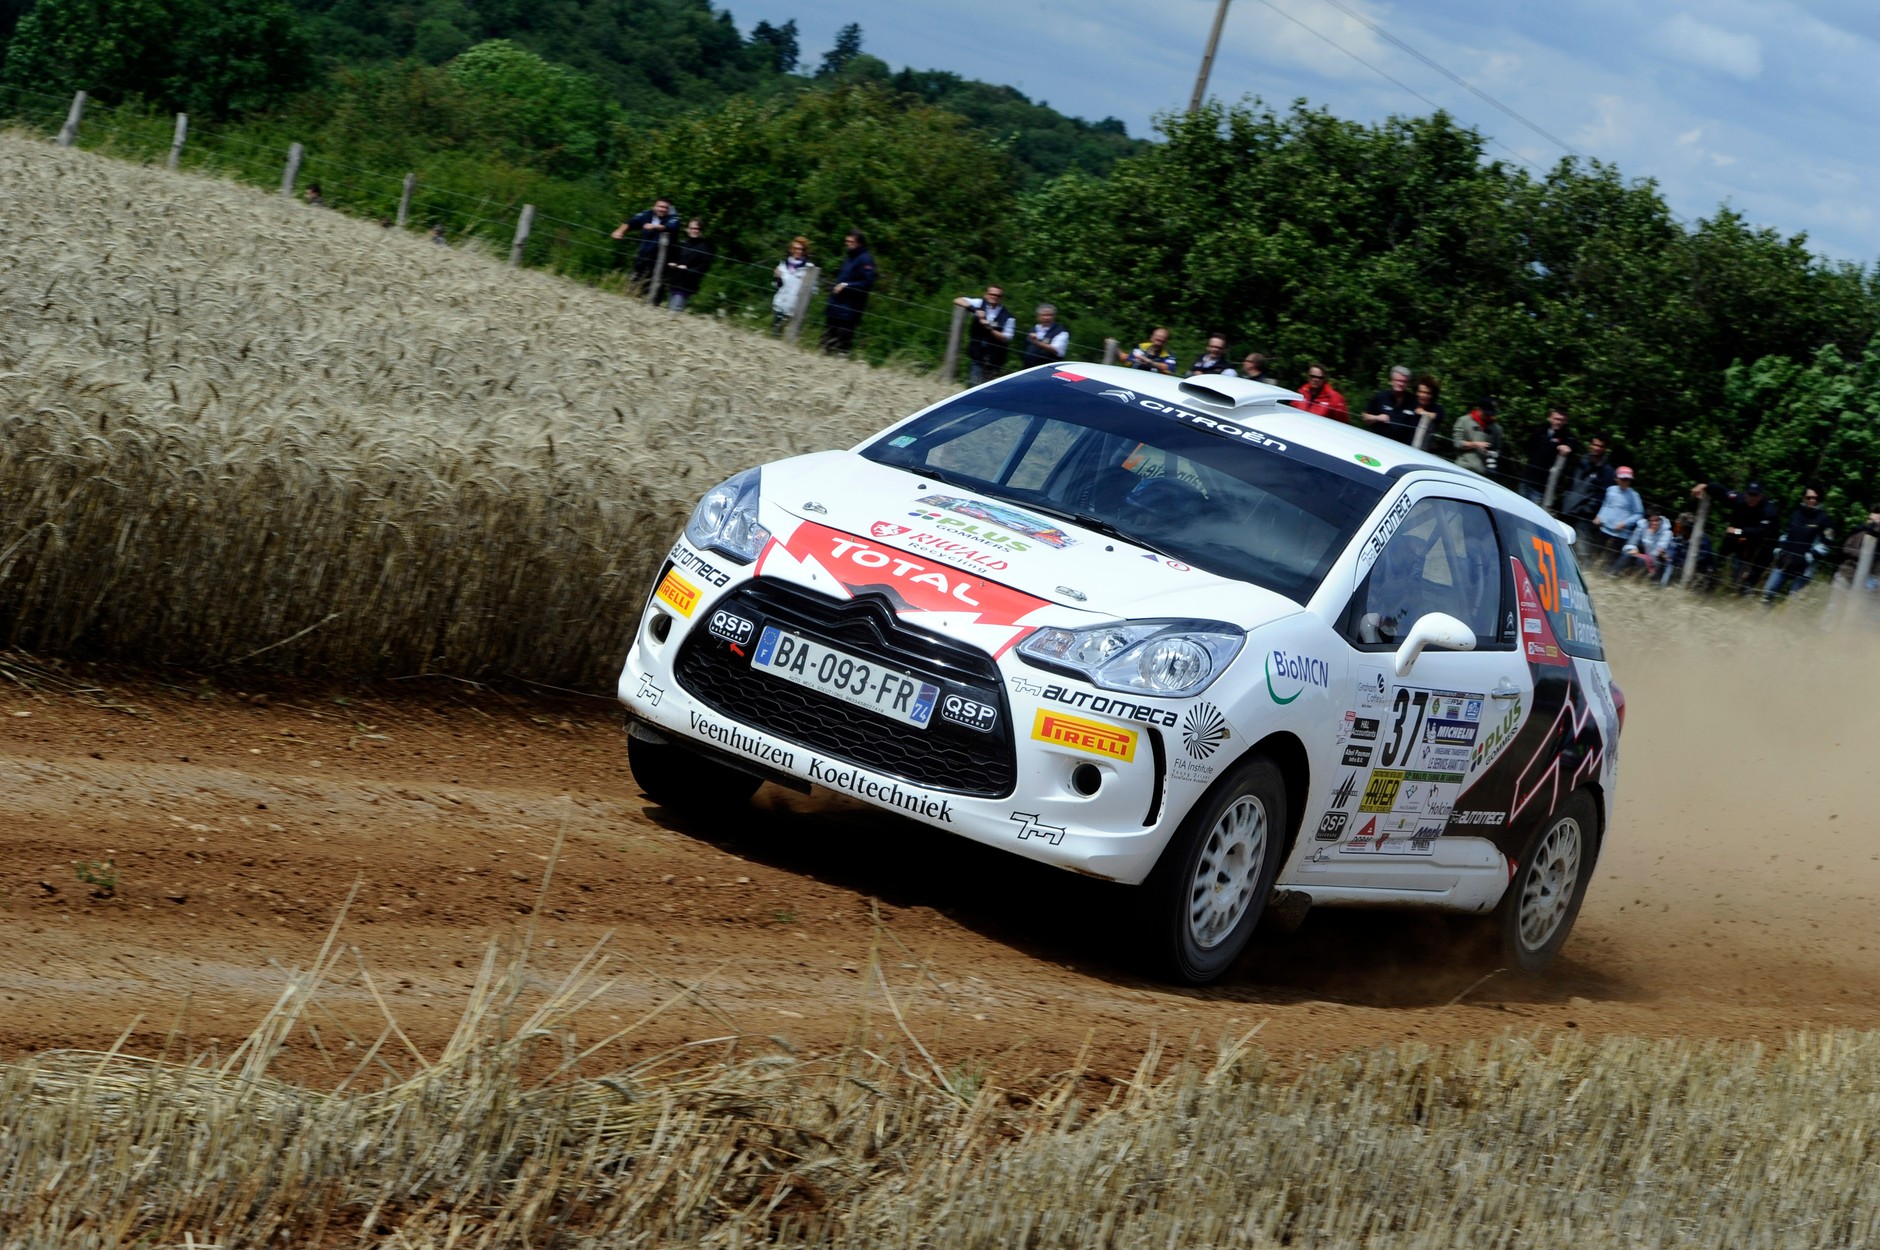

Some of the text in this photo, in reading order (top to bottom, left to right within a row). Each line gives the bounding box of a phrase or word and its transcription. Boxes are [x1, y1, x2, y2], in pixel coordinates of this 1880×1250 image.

[1139, 399, 1288, 452] CITROËN
[909, 533, 1009, 571] RIWALD
[935, 524, 1011, 553] GOMMERS
[937, 517, 1032, 552] PLUS
[829, 536, 980, 607] TOTAL
[908, 542, 987, 574] Recycling
[1531, 536, 1559, 614] 37
[713, 613, 752, 635] QSP
[760, 649, 768, 658] F
[1273, 650, 1329, 688] BioMCN
[773, 636, 914, 714] BA-093-FR
[913, 703, 927, 722] 74
[946, 699, 995, 721] QSP
[1042, 684, 1179, 728] automeca
[1041, 716, 1130, 756] PIRELLI
[1381, 688, 1429, 767] 37
[1437, 725, 1476, 740] MICHELIN
[1484, 698, 1522, 758] PLUS
[1485, 726, 1519, 765] GOMMERS
[689, 710, 954, 824] Veenhuizen Koeltechniek
[1174, 758, 1214, 774] FIA Institute
[1365, 778, 1400, 806] AUER
[1428, 802, 1452, 815] Holcim
[1320, 815, 1346, 831] QSP
[1459, 810, 1506, 825] automeca
